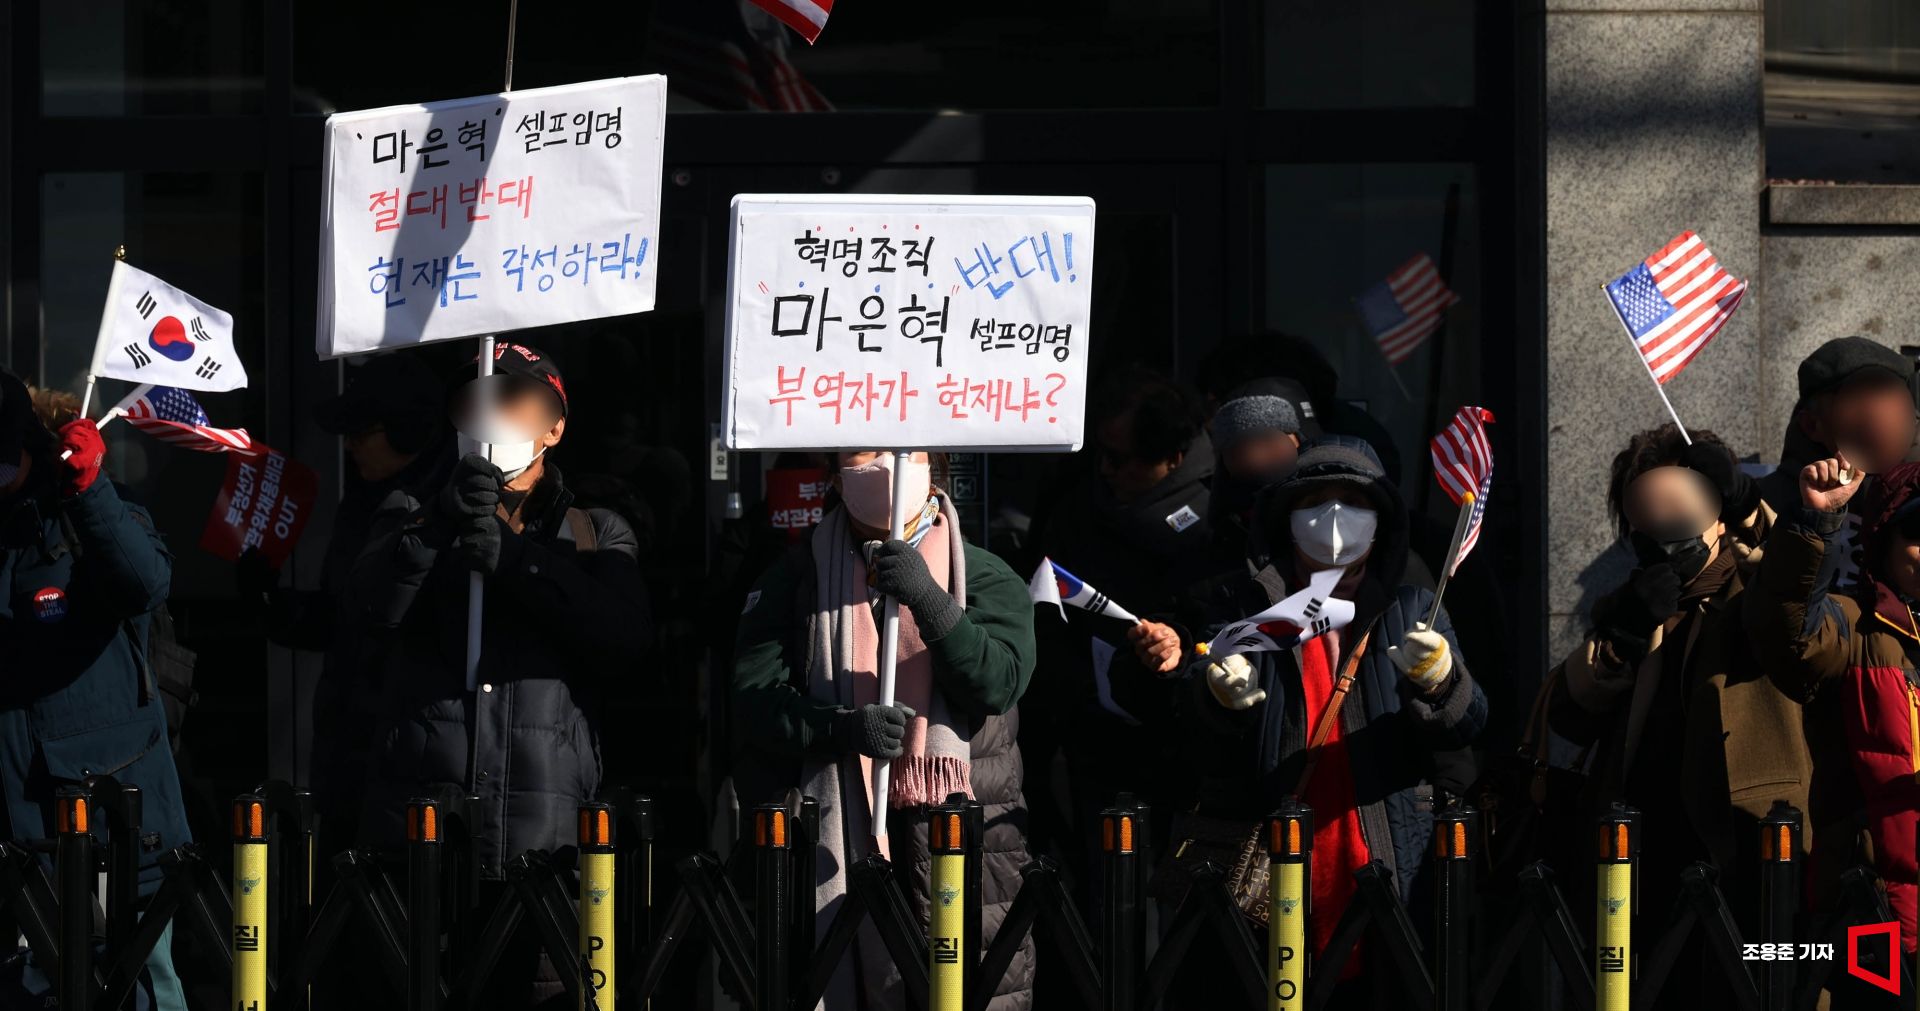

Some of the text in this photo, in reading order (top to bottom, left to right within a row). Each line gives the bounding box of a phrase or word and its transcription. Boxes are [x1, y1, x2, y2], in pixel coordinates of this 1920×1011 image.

[515, 107, 622, 154] 셀프임명
[368, 233, 649, 309] 헌재는 각성하라!
[794, 229, 1076, 300] 혁명조직 반대!
[970, 317, 1072, 362] 셀프임명
[769, 366, 1067, 427] 부역자가 헌재냐?
[224, 461, 257, 528] 부정선거
[274, 495, 299, 539] OUT
[39, 592, 59, 601] STOP
[934, 937, 958, 964] 질
[1599, 946, 1624, 973] 질
[1275, 946, 1296, 1011] PO
